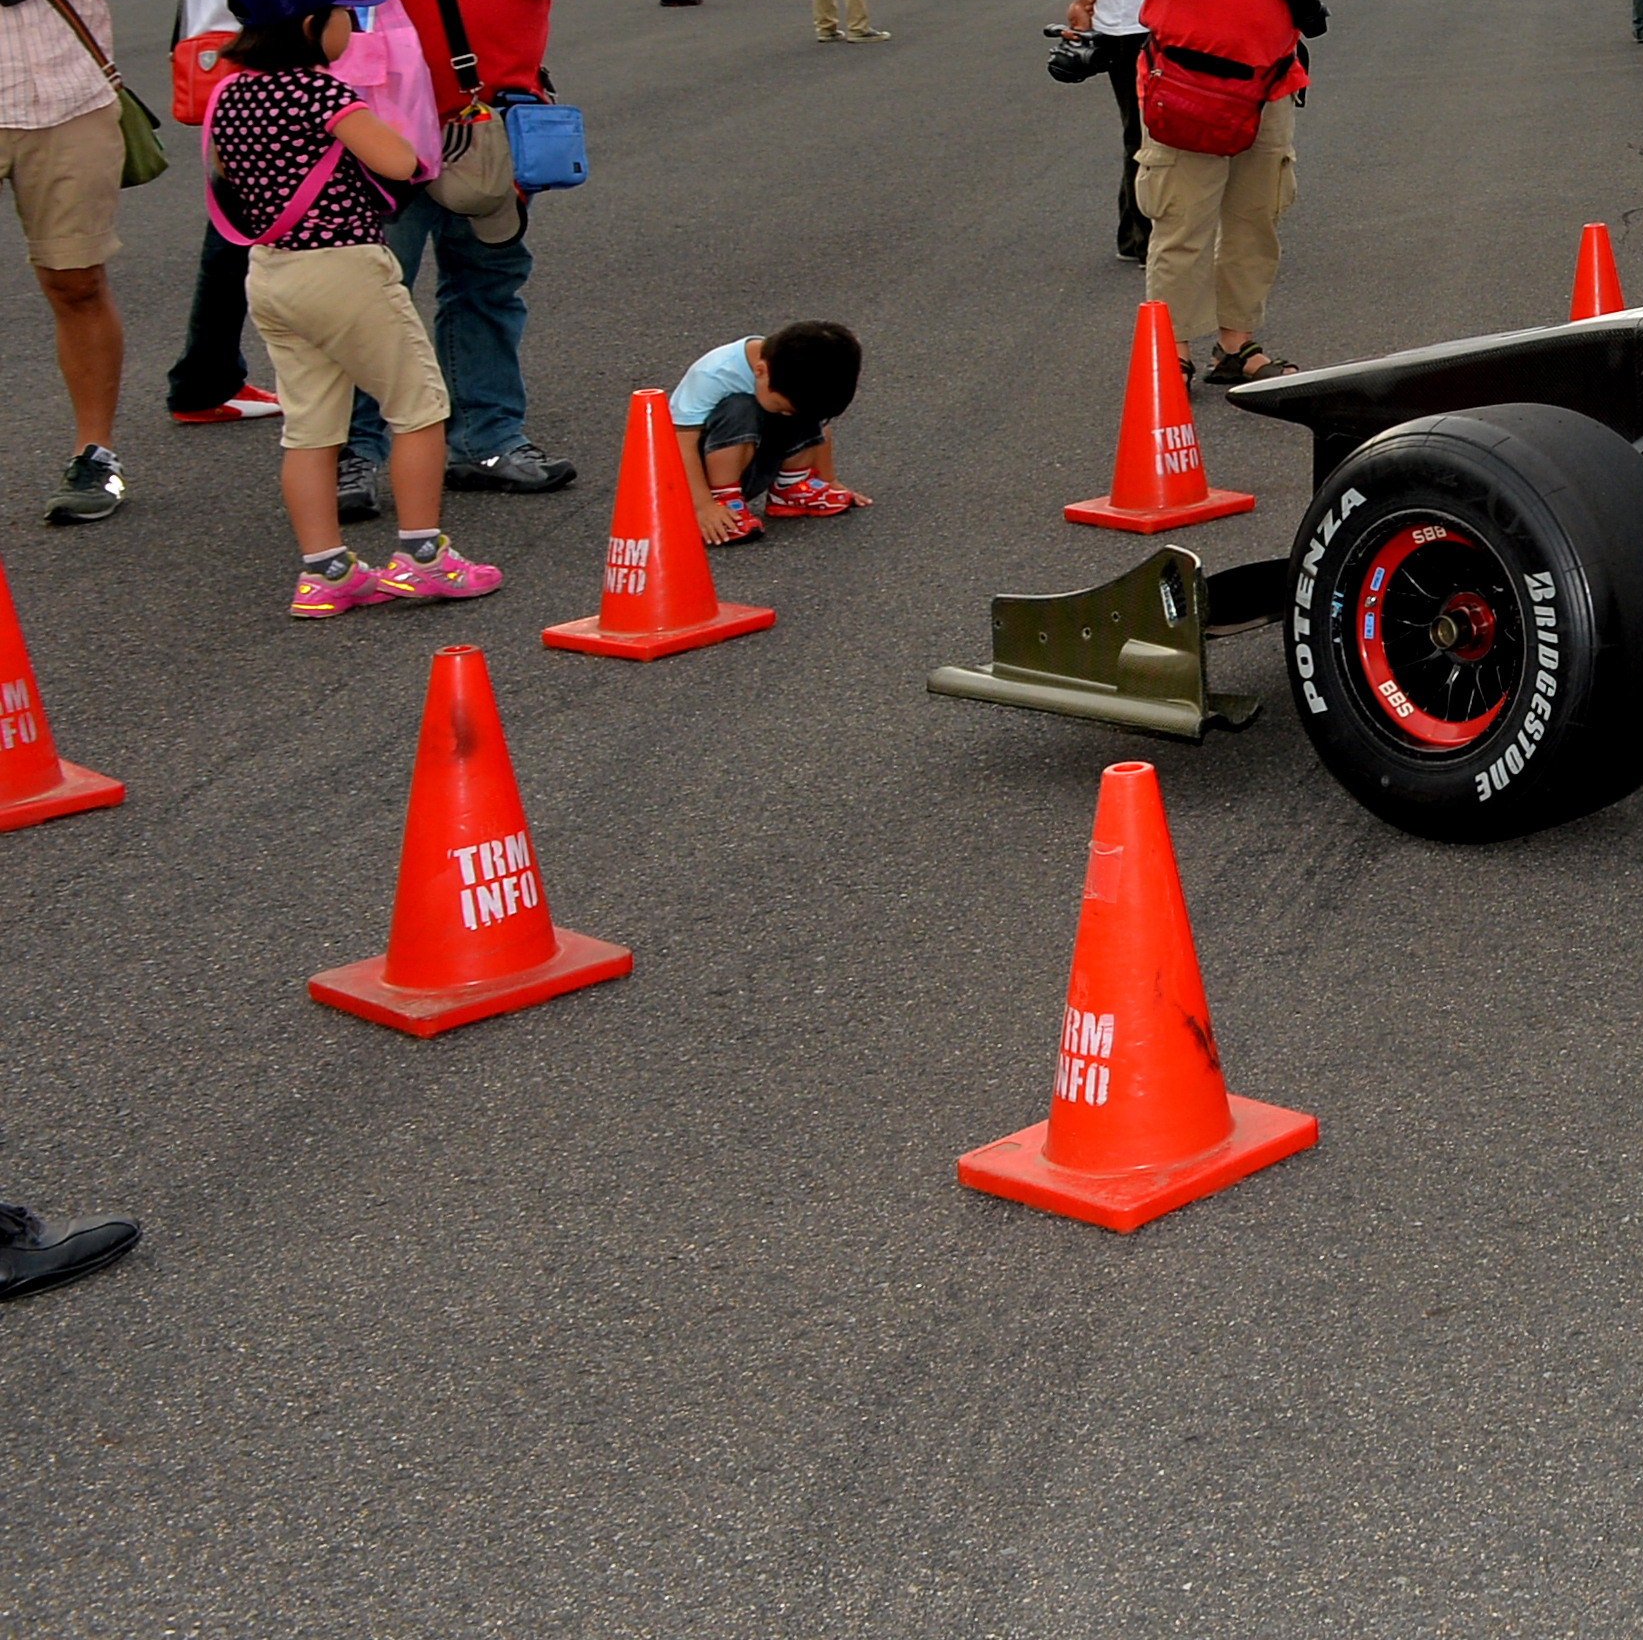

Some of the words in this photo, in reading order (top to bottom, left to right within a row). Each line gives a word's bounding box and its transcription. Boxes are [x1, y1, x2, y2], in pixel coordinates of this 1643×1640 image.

[1151, 424, 1195, 452] TRM
[1155, 448, 1201, 475] INFO
[1412, 525, 1448, 545] BBS
[1294, 487, 1368, 714] POTENZA
[1378, 679, 1415, 718] BBS
[1475, 570, 1560, 802] BRIDGESTONE
[454, 830, 531, 885] TRM
[459, 871, 539, 931] INFO
